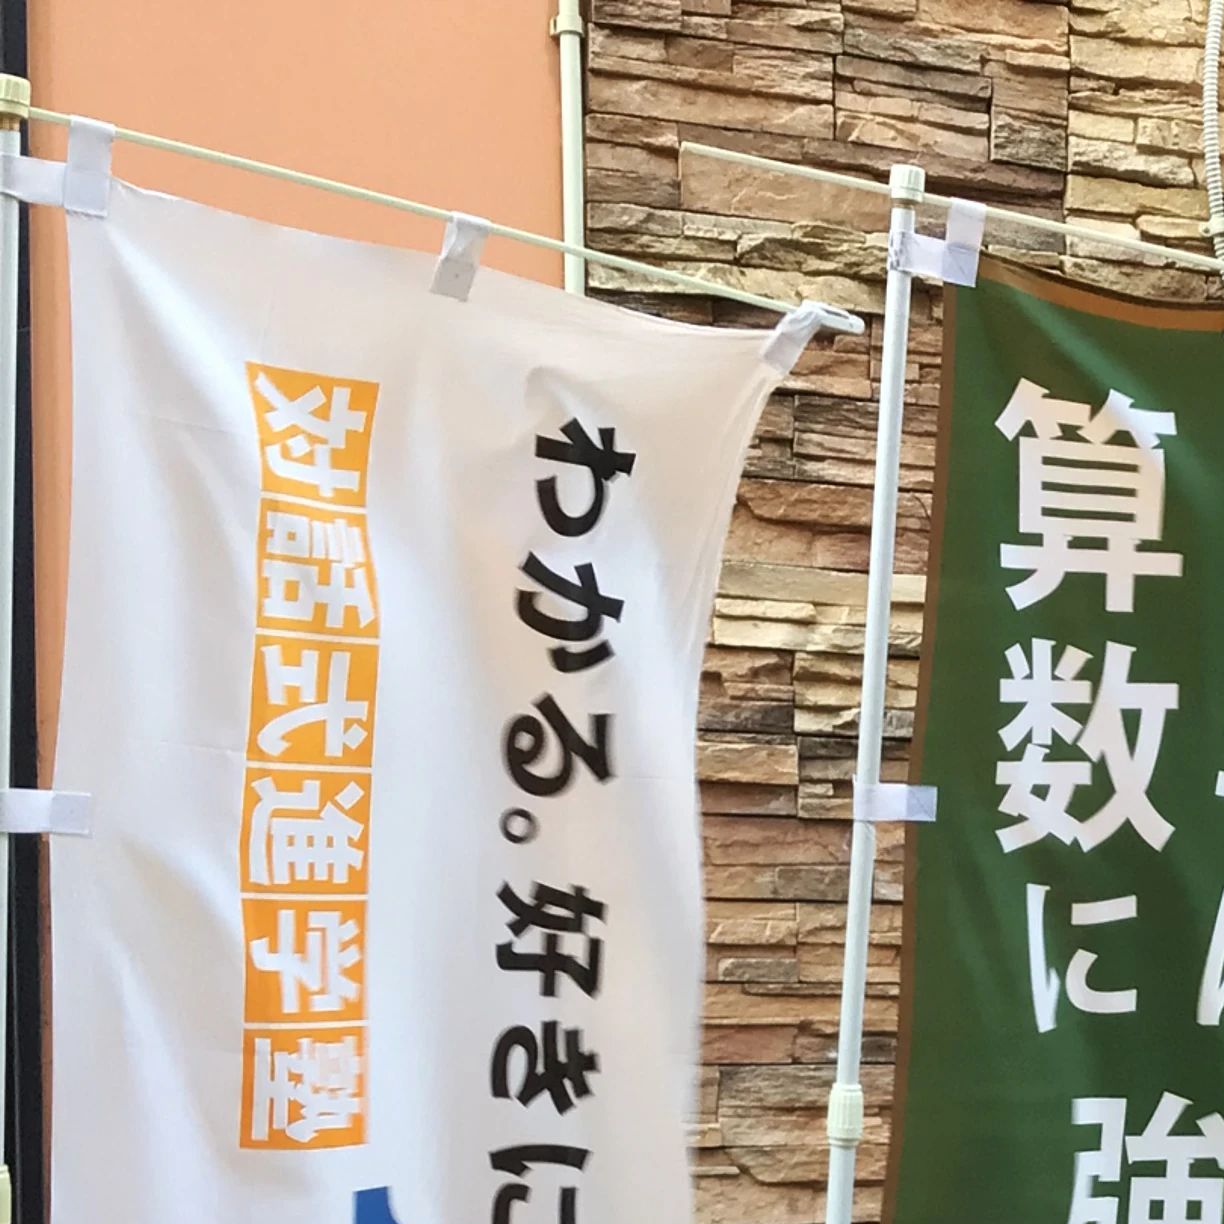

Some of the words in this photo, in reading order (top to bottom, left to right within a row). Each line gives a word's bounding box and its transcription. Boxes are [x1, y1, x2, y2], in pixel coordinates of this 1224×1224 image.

[250, 371, 375, 1145] 対話式進学塾
[994, 377, 1184, 1034] 算数に
